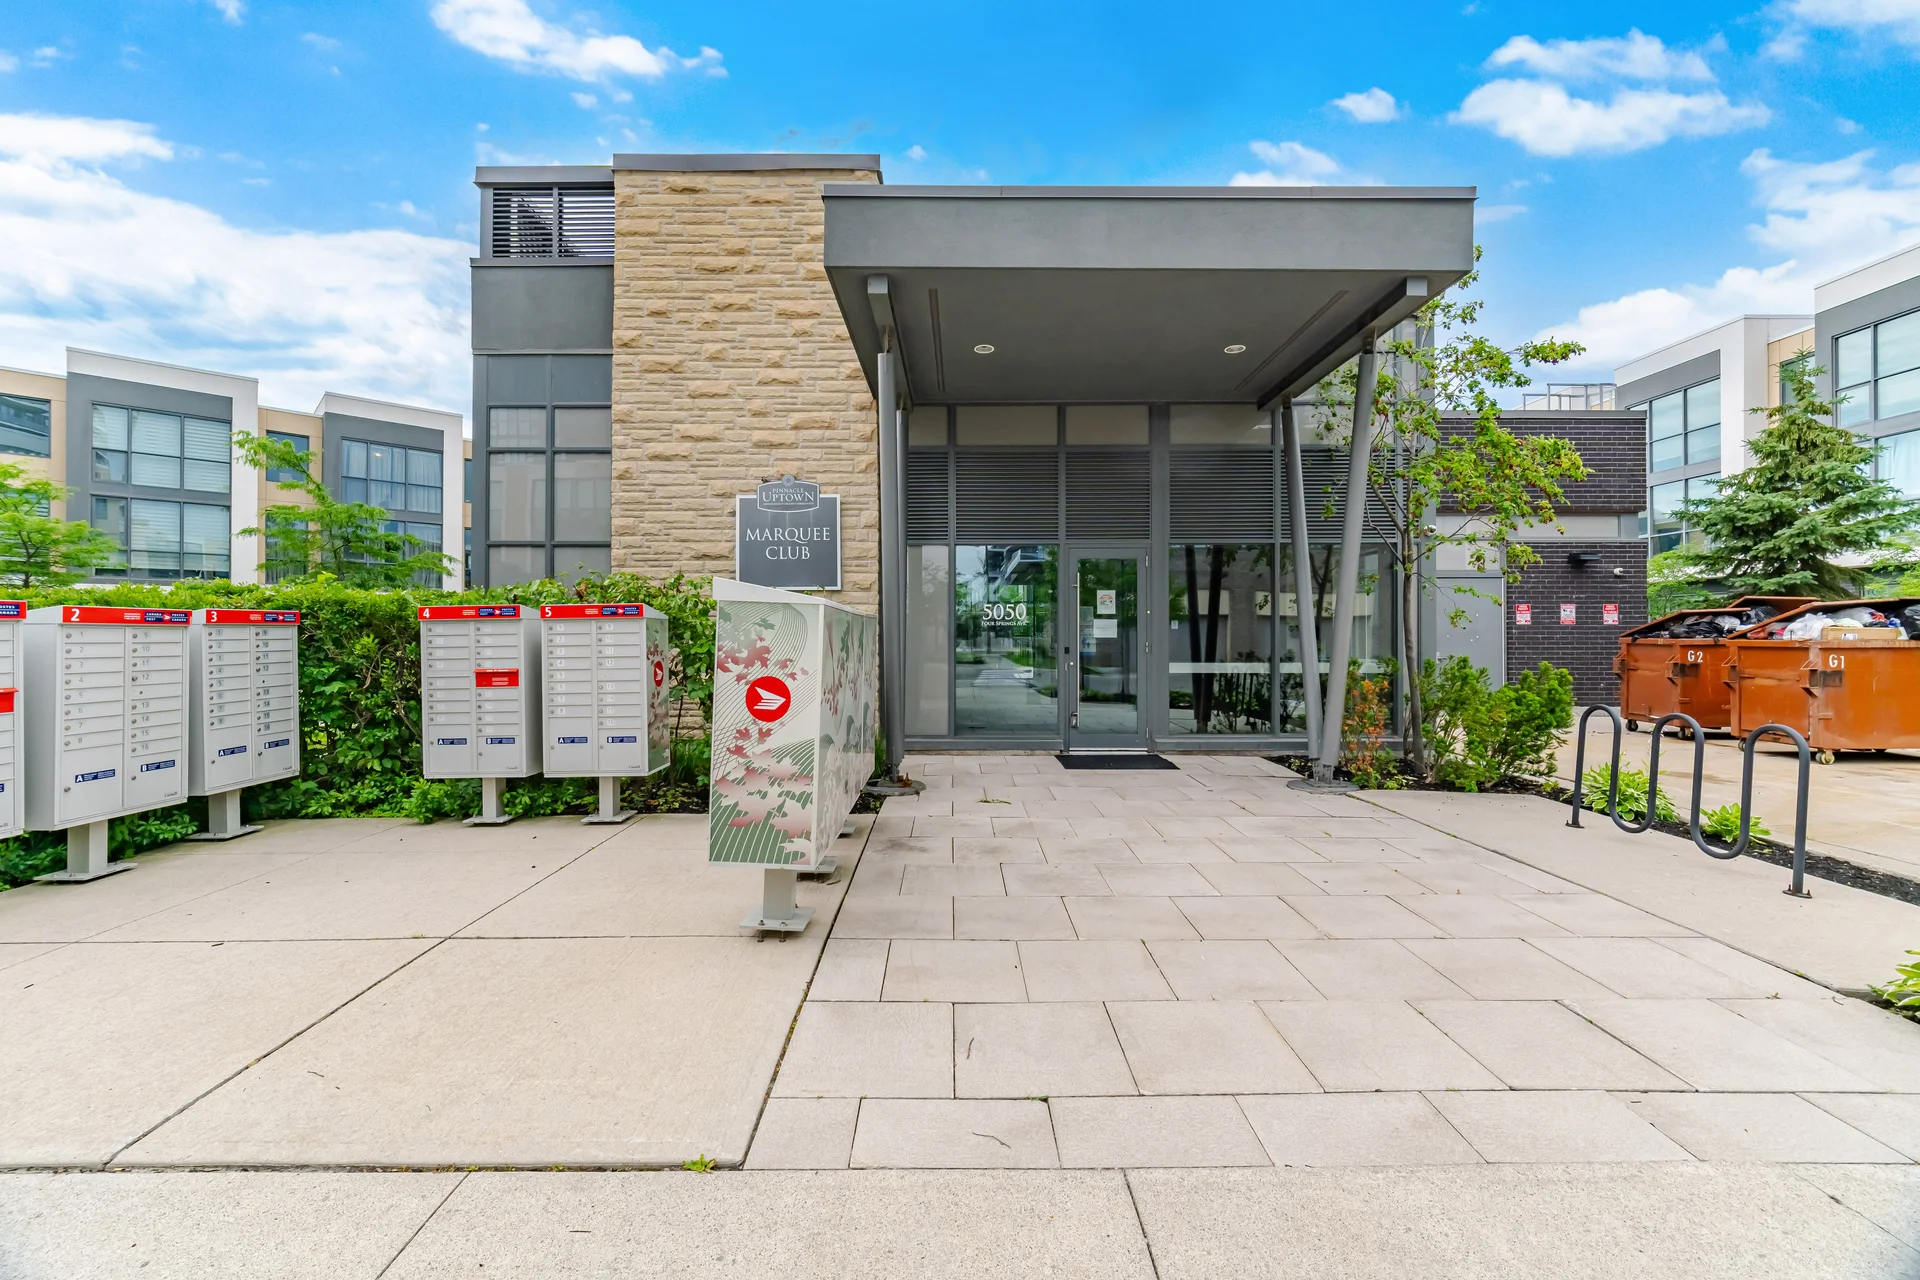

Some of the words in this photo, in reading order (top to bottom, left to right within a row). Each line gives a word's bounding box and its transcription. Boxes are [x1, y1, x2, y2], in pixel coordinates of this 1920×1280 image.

[762, 491, 814, 502] UPTOWN
[746, 527, 830, 543] MARQUEE
[765, 546, 810, 560] CLUB
[71, 608, 80, 622] 2
[211, 611, 218, 622] 3
[423, 608, 430, 618] 4
[545, 606, 552, 617] 5
[982, 603, 1027, 620] 5050
[1688, 650, 1703, 663] G2
[1829, 654, 1845, 669] G1
